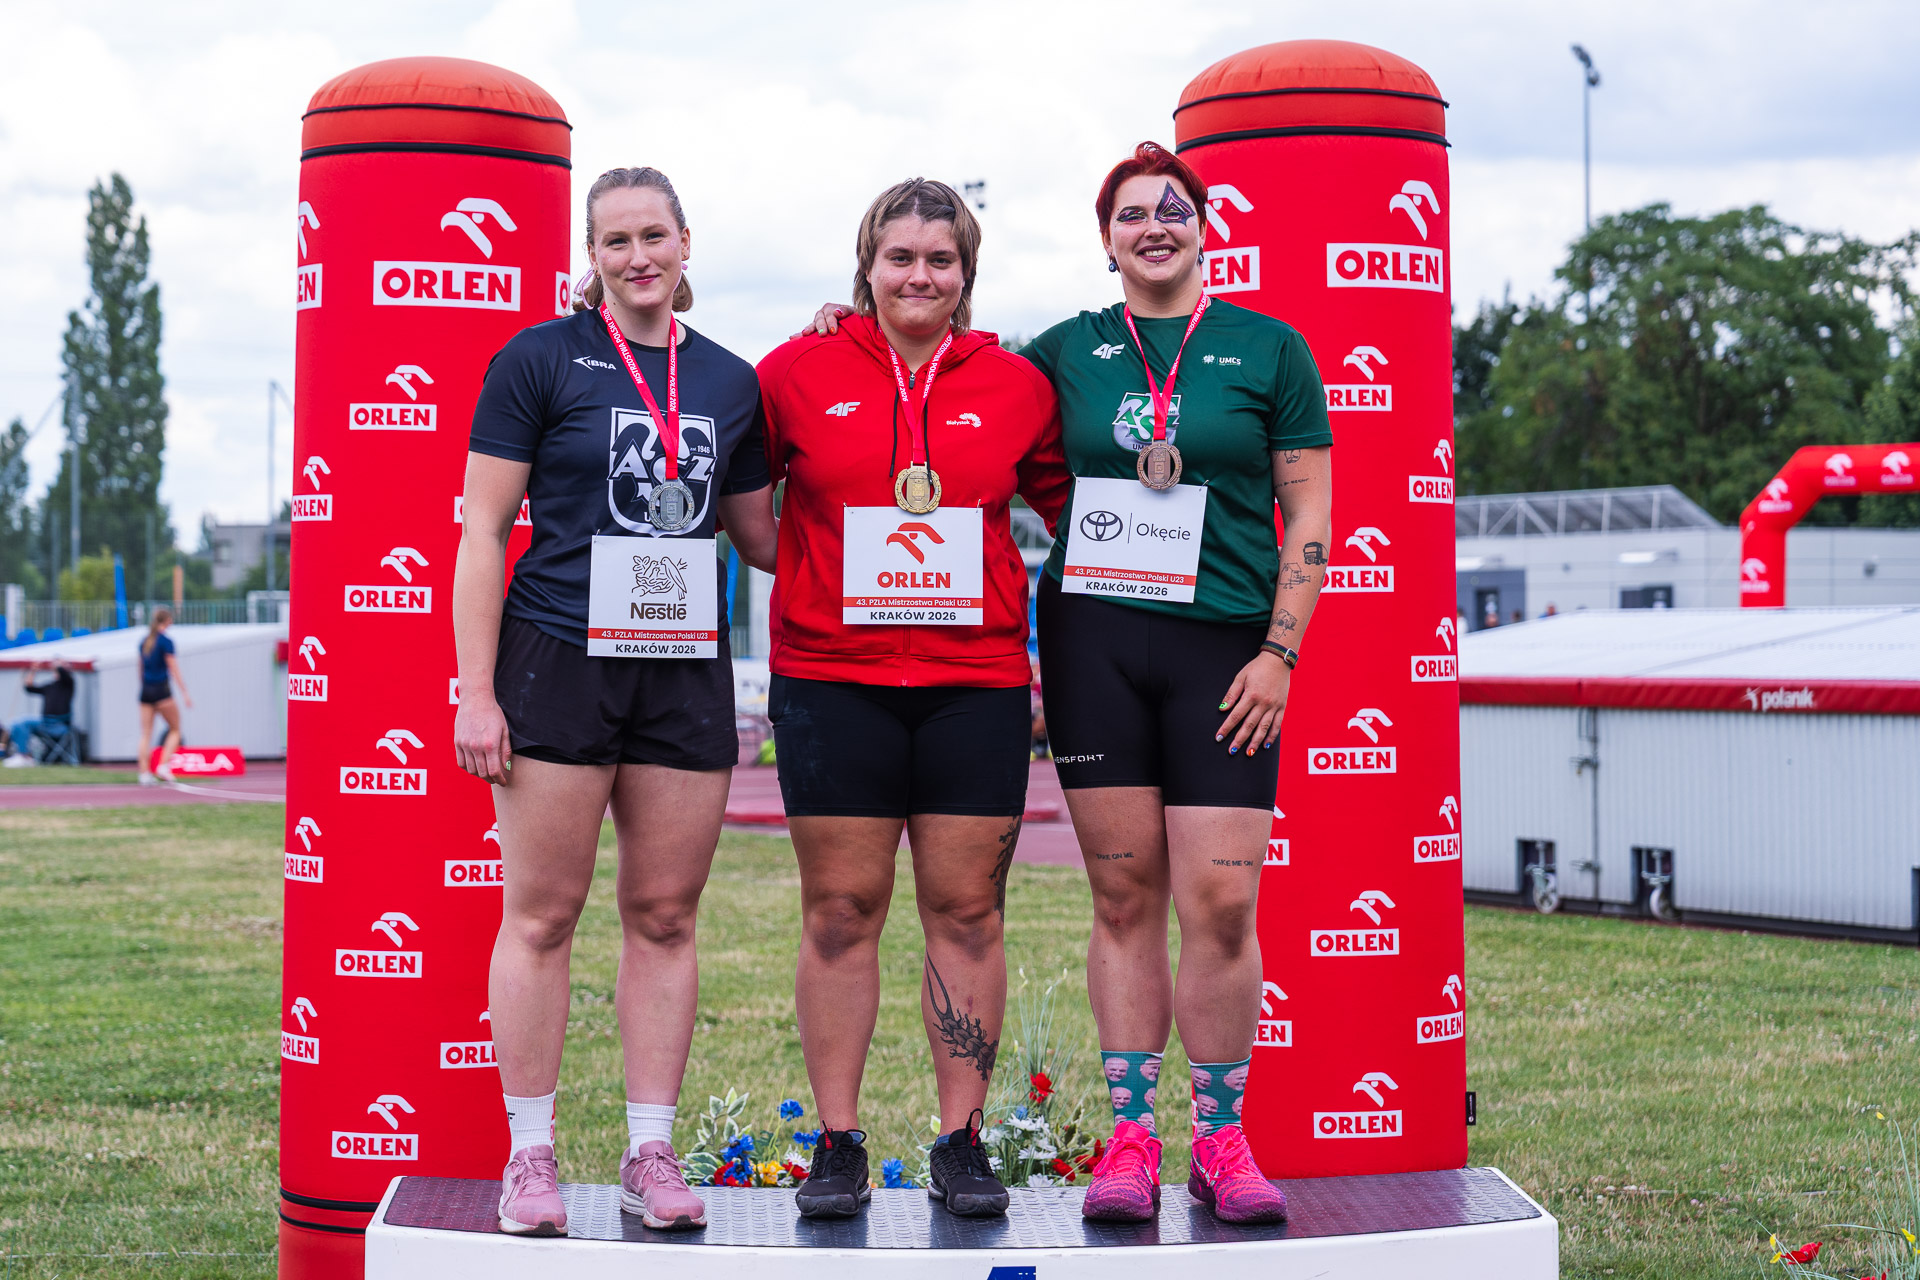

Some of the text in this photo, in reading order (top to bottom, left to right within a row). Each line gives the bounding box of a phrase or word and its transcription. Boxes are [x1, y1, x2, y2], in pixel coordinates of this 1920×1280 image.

[1335, 250, 1440, 285] ORLEN
[381, 267, 512, 304] ORLEN
[602, 308, 644, 384] MISTRZOSTWA POLSKI 2026
[1092, 343, 1125, 359] 4F
[1325, 389, 1387, 407] RLEN
[353, 407, 431, 426] ORLEN
[825, 401, 861, 417] 4F
[1412, 480, 1452, 500] ORLEN
[293, 498, 328, 517] ORLEN
[1136, 523, 1191, 541] Okęcie
[877, 571, 951, 589] ORLEN
[1075, 568, 1085, 576] 43.
[1103, 570, 1146, 580] Mistrzostwa
[1147, 574, 1169, 582] Polski
[1170, 576, 1184, 584] U23
[1085, 581, 1168, 596] KRAKÓW 2026
[349, 589, 425, 609] ORLEN
[856, 598, 868, 606] 43.
[888, 599, 933, 607] Mistrzostwa
[934, 599, 956, 607] Polski
[870, 609, 957, 621] KRAKÓW 2026
[601, 630, 708, 640] 43. PZLA Mistrzostwa Polski U23
[615, 643, 696, 654] KRAKÓW 2026
[1415, 660, 1456, 678] ORLEN
[289, 678, 323, 697] ORLEN
[1761, 685, 1814, 713] polanik
[1055, 753, 1105, 764] ENSFORT
[1313, 751, 1391, 770] ORLEN
[344, 771, 421, 791] ORLEN
[1417, 838, 1459, 859] ORLEN
[285, 857, 319, 878] ORLEN
[450, 864, 504, 883] ORLE
[1316, 933, 1394, 952] ORLEN
[340, 954, 416, 974] ORLEN
[1420, 1015, 1462, 1039] ORLEN
[282, 1035, 315, 1060] ORLEN
[1319, 1115, 1397, 1134] ORLEN
[336, 1135, 412, 1157] ORLEN
